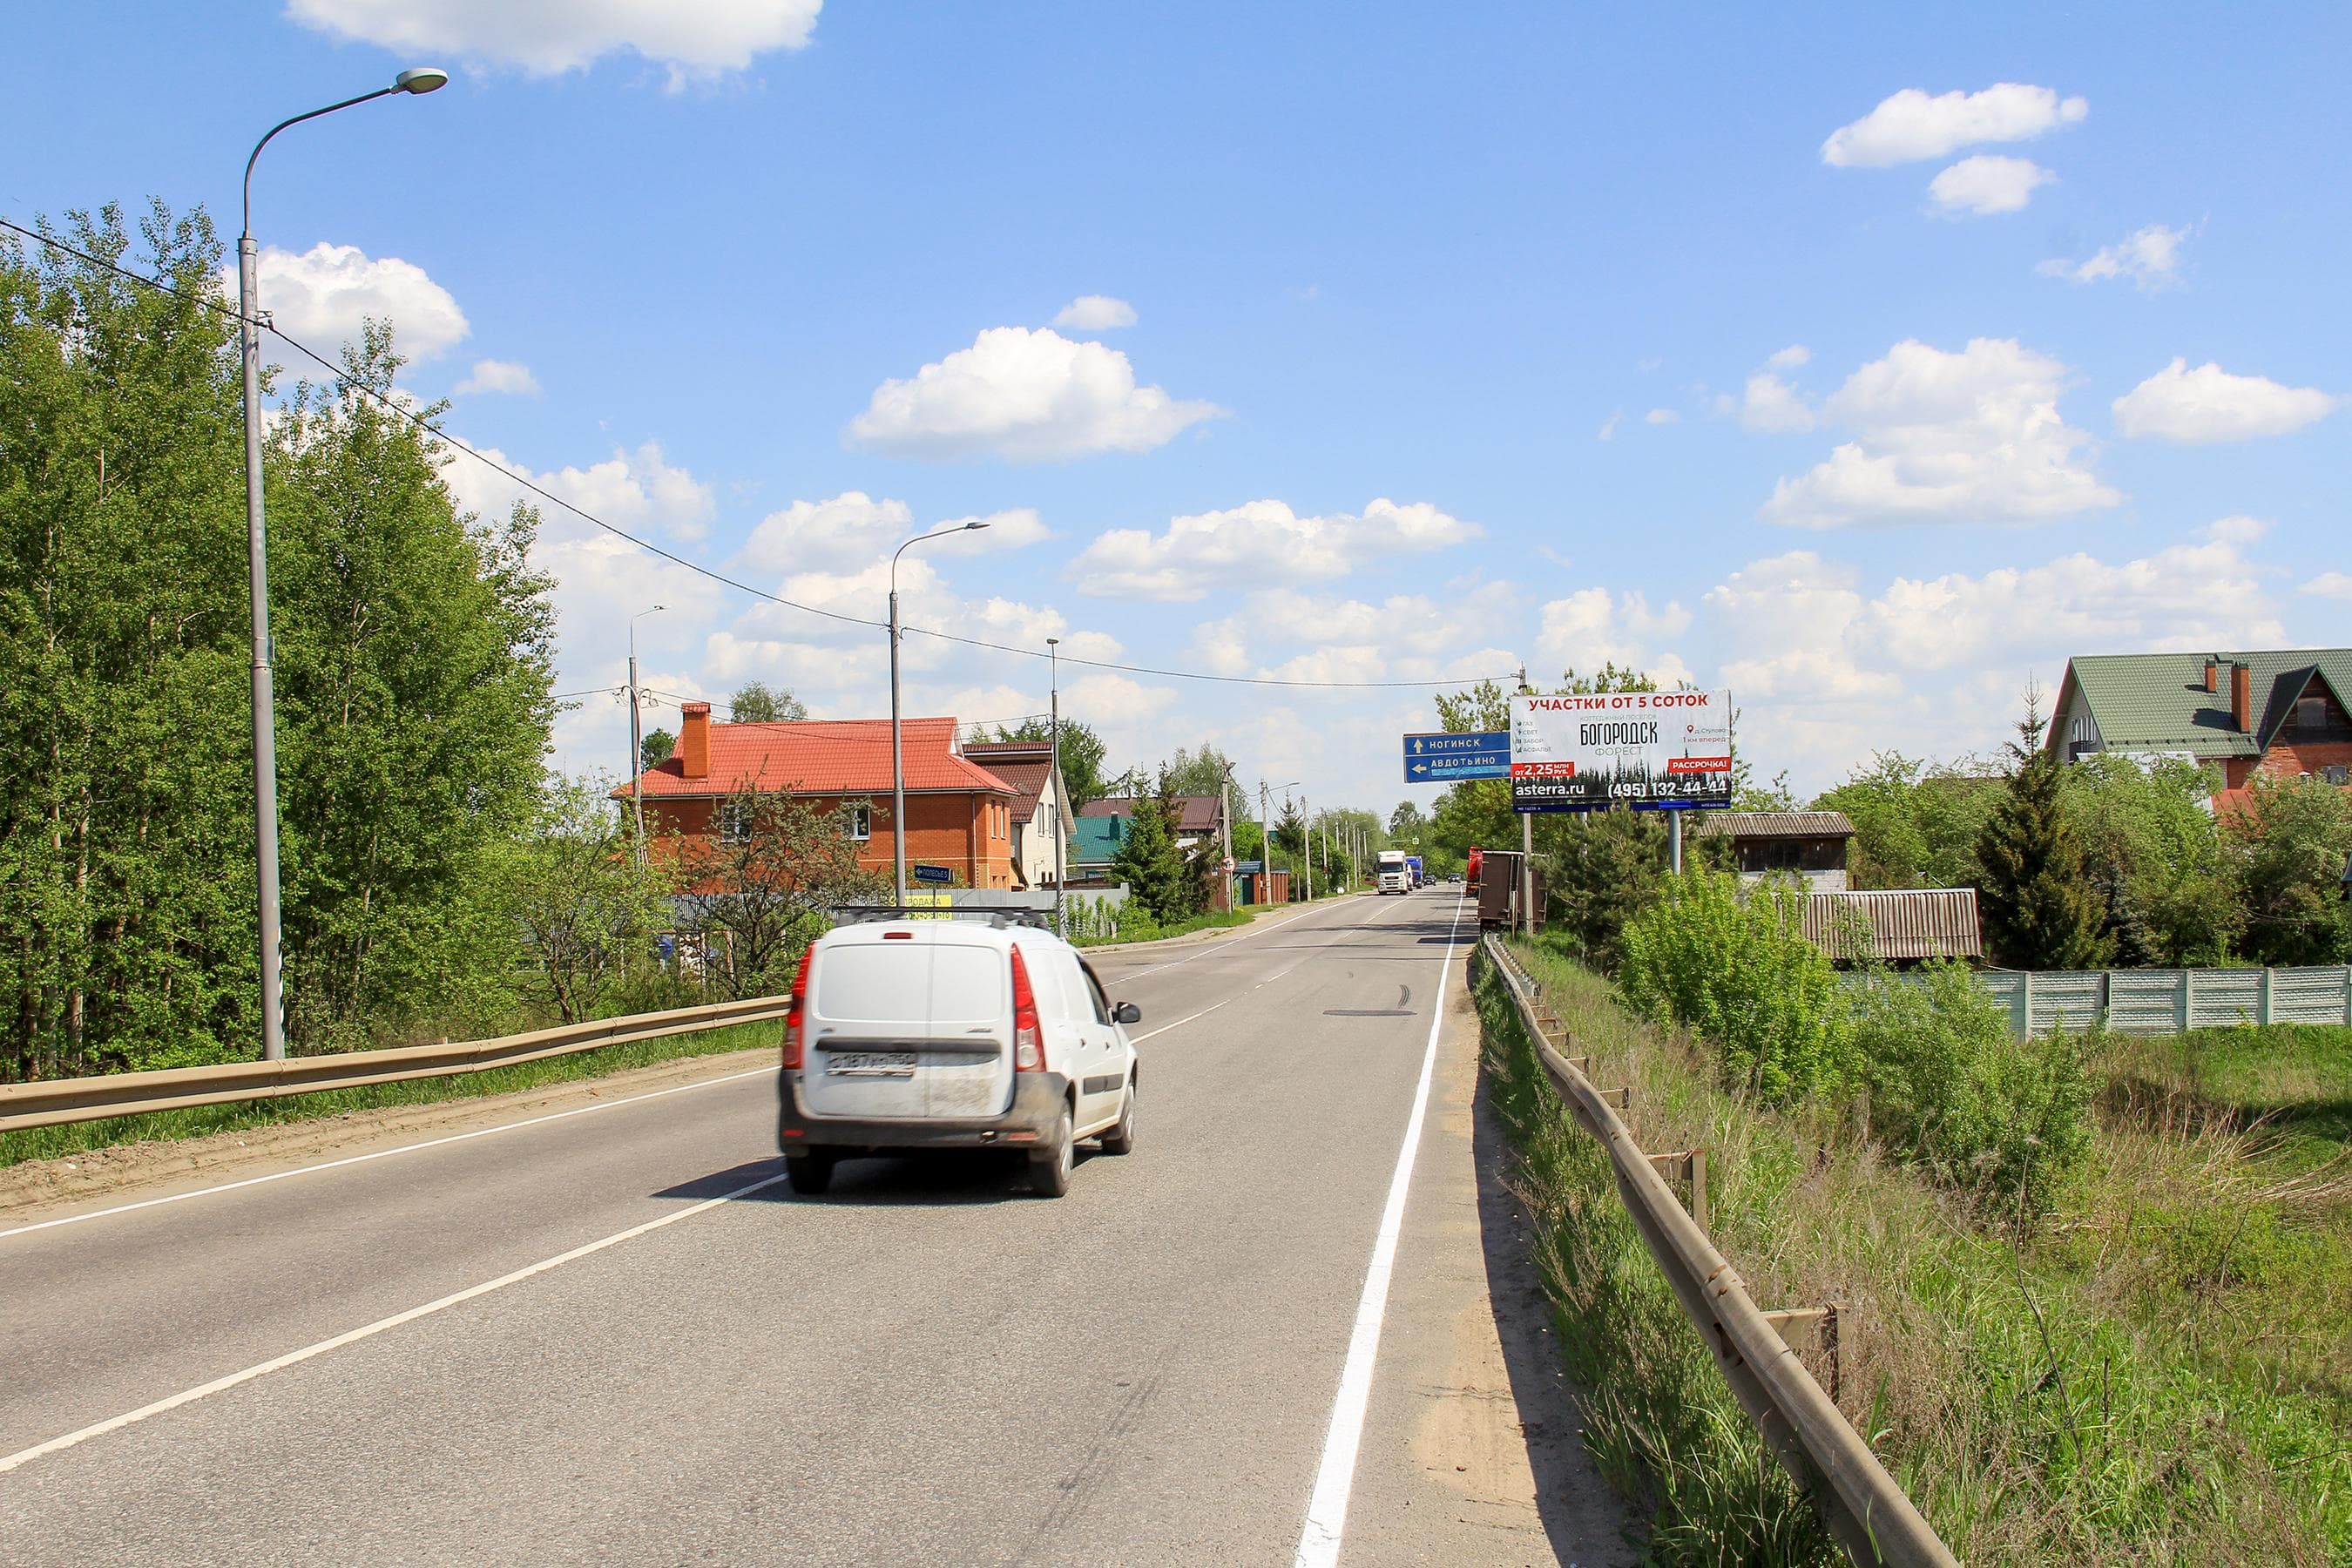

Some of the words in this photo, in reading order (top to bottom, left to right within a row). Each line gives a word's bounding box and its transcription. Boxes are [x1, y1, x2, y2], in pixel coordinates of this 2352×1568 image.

[1529, 698, 1605, 711] УЧАСТКИ
[1612, 697, 1632, 709] ОТ
[1639, 697, 1647, 708] 5
[1652, 694, 1708, 707] СОТОК
[1580, 721, 1658, 746] БОГОРОДСК
[1429, 739, 1481, 749] НОГИНСК
[1594, 747, 1644, 756] ФОРЕСТ
[1431, 756, 1496, 767] АВДОТЬИНО
[1673, 760, 1727, 769] РАССРОЧКА!
[1524, 764, 1553, 776] 2,25
[1516, 784, 1585, 796] asterra.ru
[1608, 782, 1646, 798] (495)
[1652, 781, 1727, 795] 132-44-44
